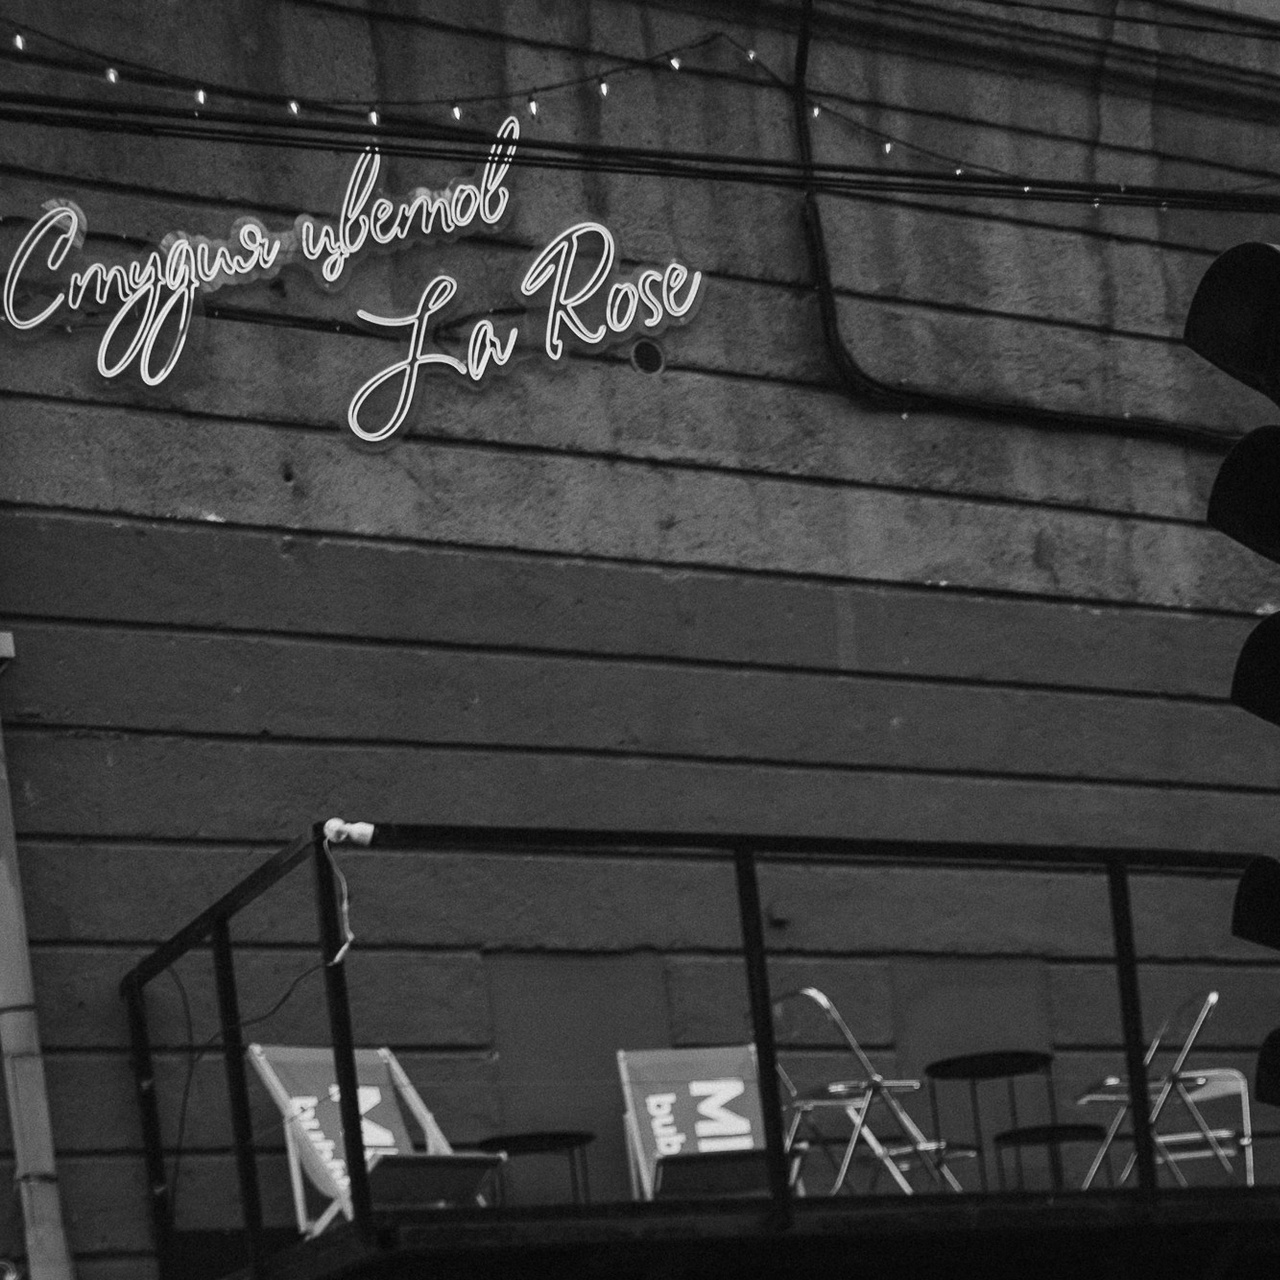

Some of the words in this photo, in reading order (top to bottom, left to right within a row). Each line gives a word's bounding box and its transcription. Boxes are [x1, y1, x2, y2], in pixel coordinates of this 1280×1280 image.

[302, 116, 520, 281] цветов
[348, 276, 516, 442] La
[522, 222, 702, 360] Rose
